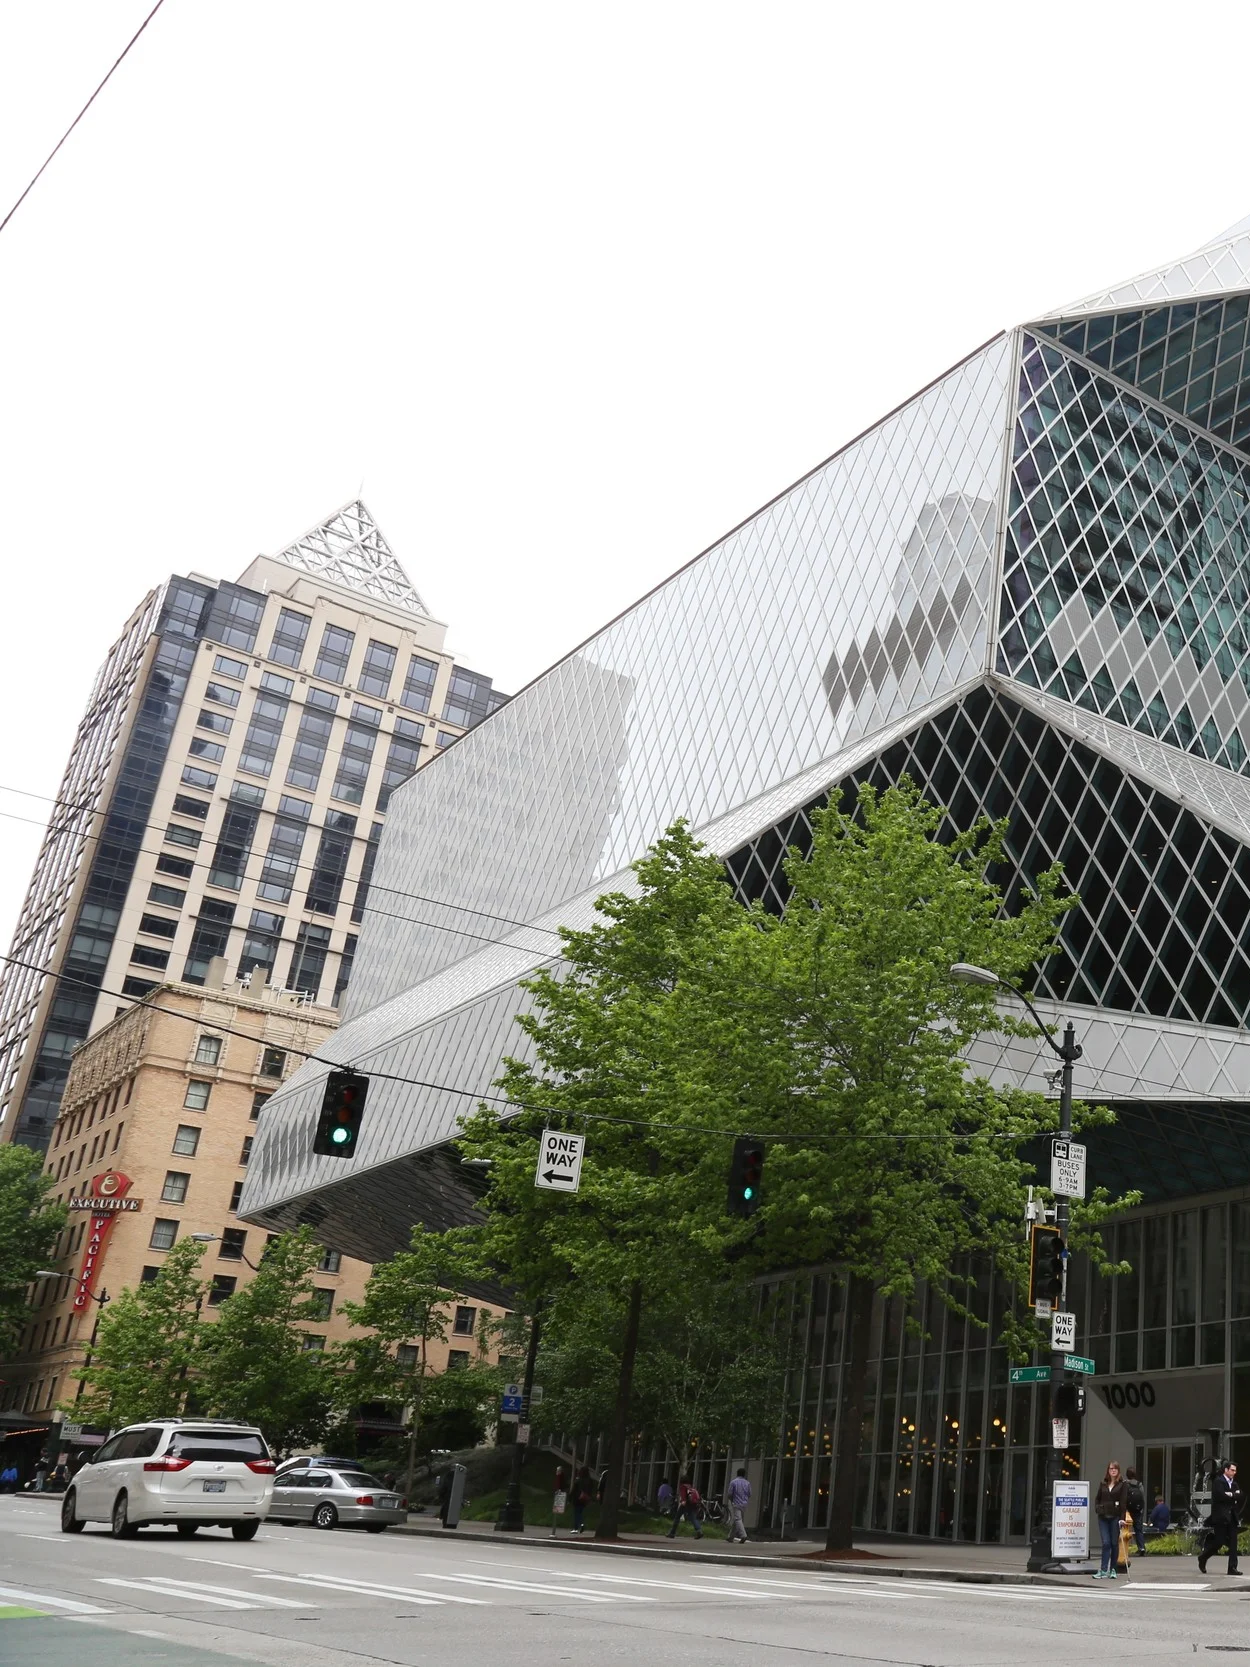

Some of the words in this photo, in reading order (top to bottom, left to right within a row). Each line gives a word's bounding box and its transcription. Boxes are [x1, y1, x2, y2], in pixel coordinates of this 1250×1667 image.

[547, 1137, 578, 1153] ONE
[1070, 1146, 1083, 1155] CURB
[546, 1151, 577, 1168] WAY
[1070, 1153, 1083, 1161] LANE
[1057, 1160, 1080, 1171] BUSES
[1059, 1168, 1077, 1178] ONLY
[69, 1198, 139, 1211] EXECUTIVE
[74, 1220, 104, 1306] PACIFIC
[1055, 1315, 1073, 1326] ONE
[1055, 1325, 1073, 1336] WAY
[1064, 1356, 1084, 1370] Madison
[1036, 1370, 1047, 1378] Ave
[1102, 1381, 1155, 1409] 1000
[509, 1398, 516, 1407] 2
